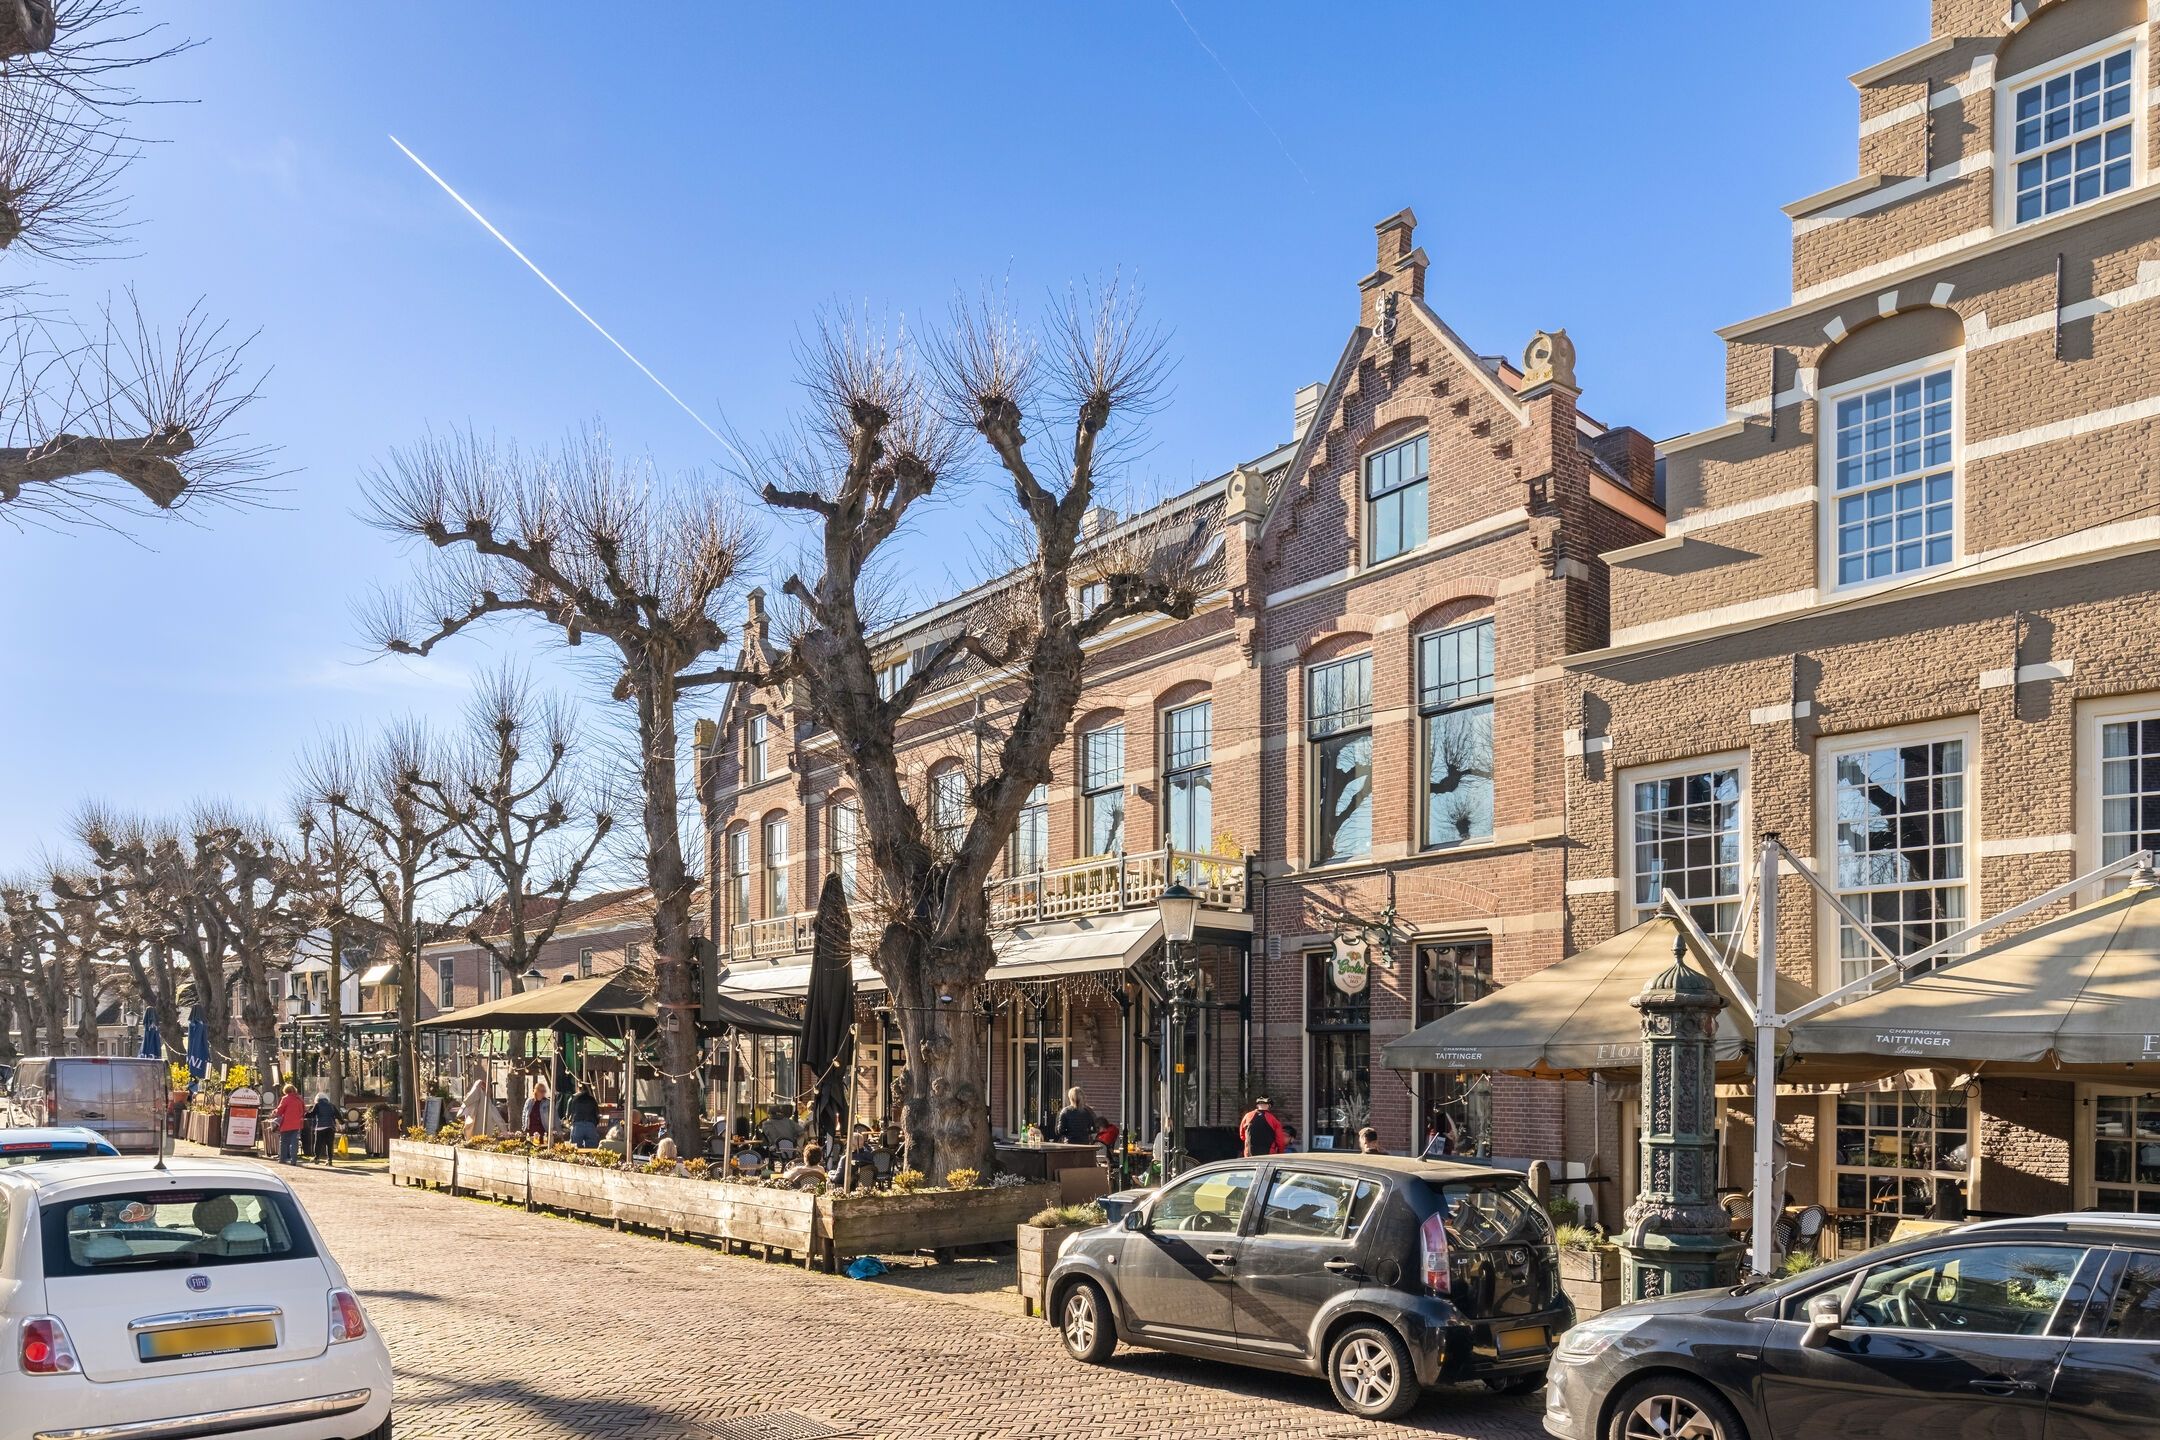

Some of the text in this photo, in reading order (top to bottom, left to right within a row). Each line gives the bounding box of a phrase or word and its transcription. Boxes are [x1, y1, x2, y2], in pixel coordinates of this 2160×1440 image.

[1875, 1034, 1951, 1046] TAITTINGER
[1435, 1052, 1482, 1060] TAITTINGER
[192, 1277, 207, 1287] FIAT
